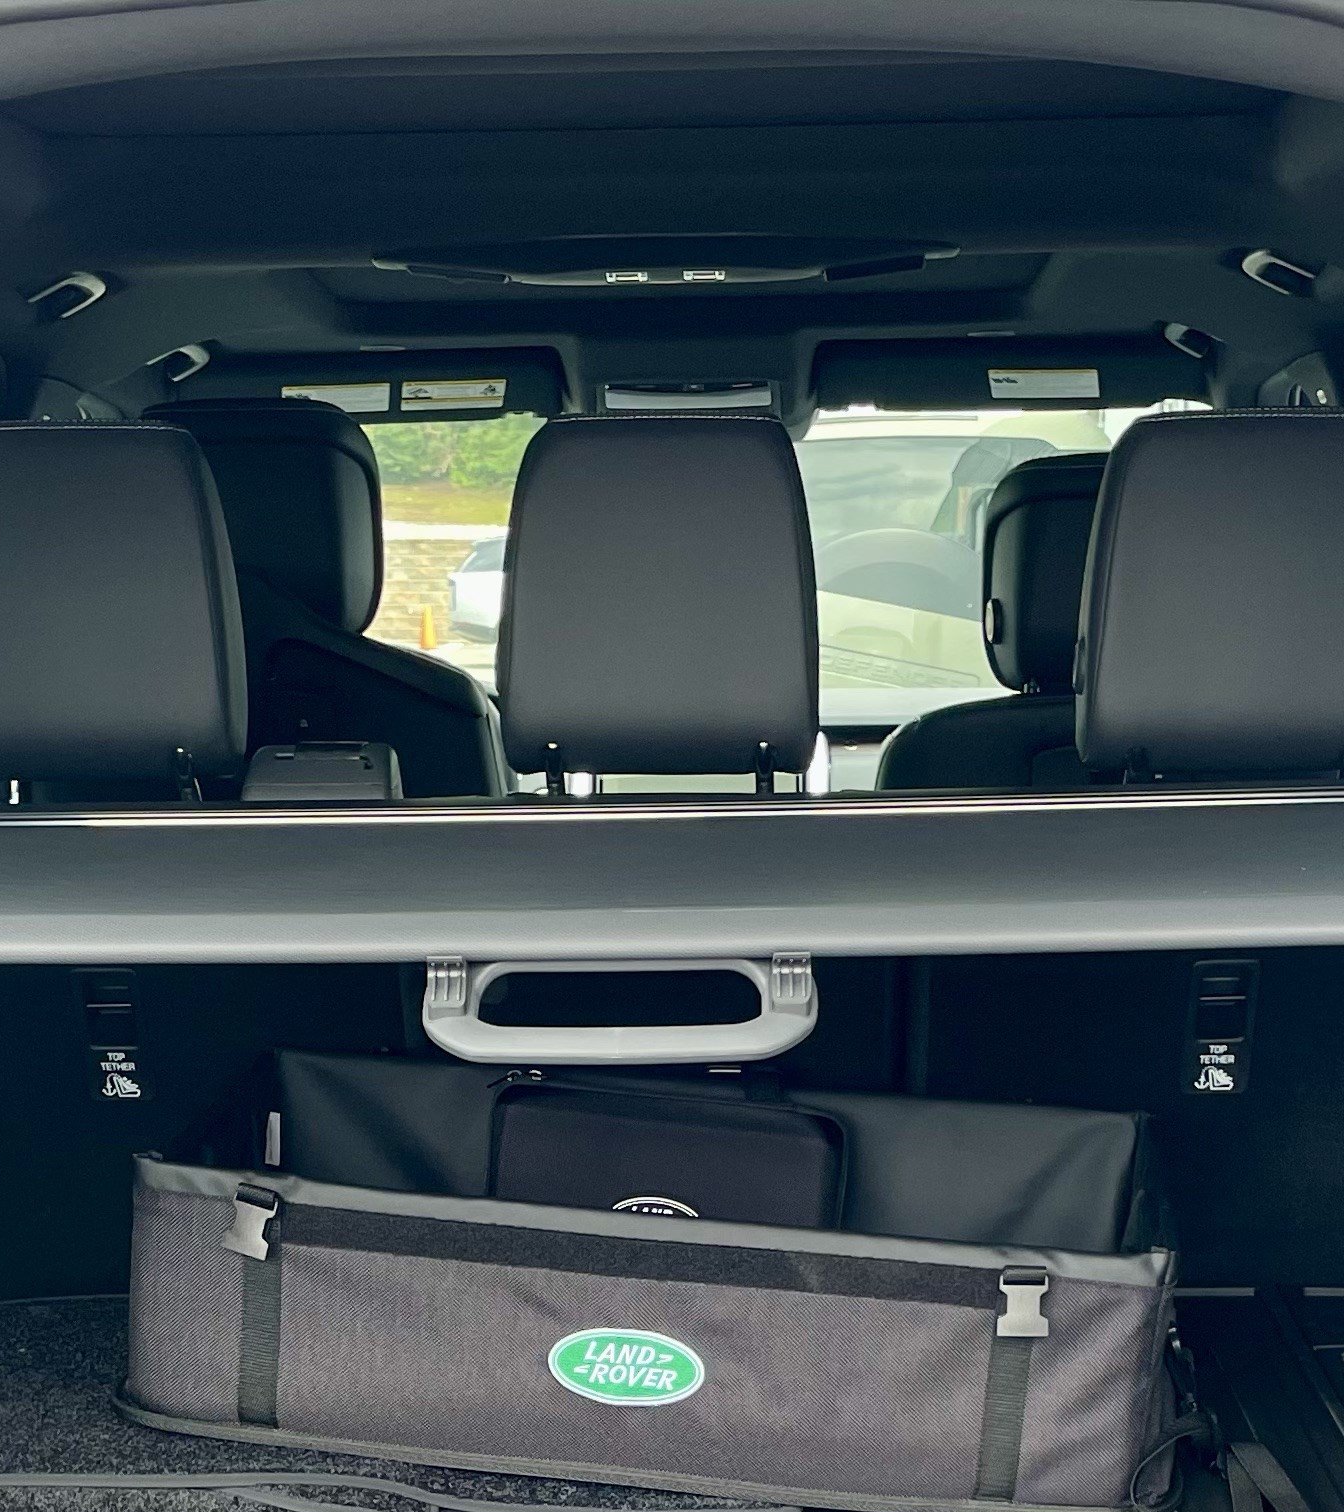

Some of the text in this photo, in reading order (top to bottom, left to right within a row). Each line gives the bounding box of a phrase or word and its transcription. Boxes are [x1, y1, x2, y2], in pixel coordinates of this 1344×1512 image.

[1208, 1044, 1228, 1054] TOP
[106, 1052, 126, 1061] TOP
[1199, 1055, 1235, 1064] TETHER
[100, 1062, 136, 1071] TETHER
[582, 1341, 656, 1365] LAND
[588, 1363, 678, 1391] ROVER
